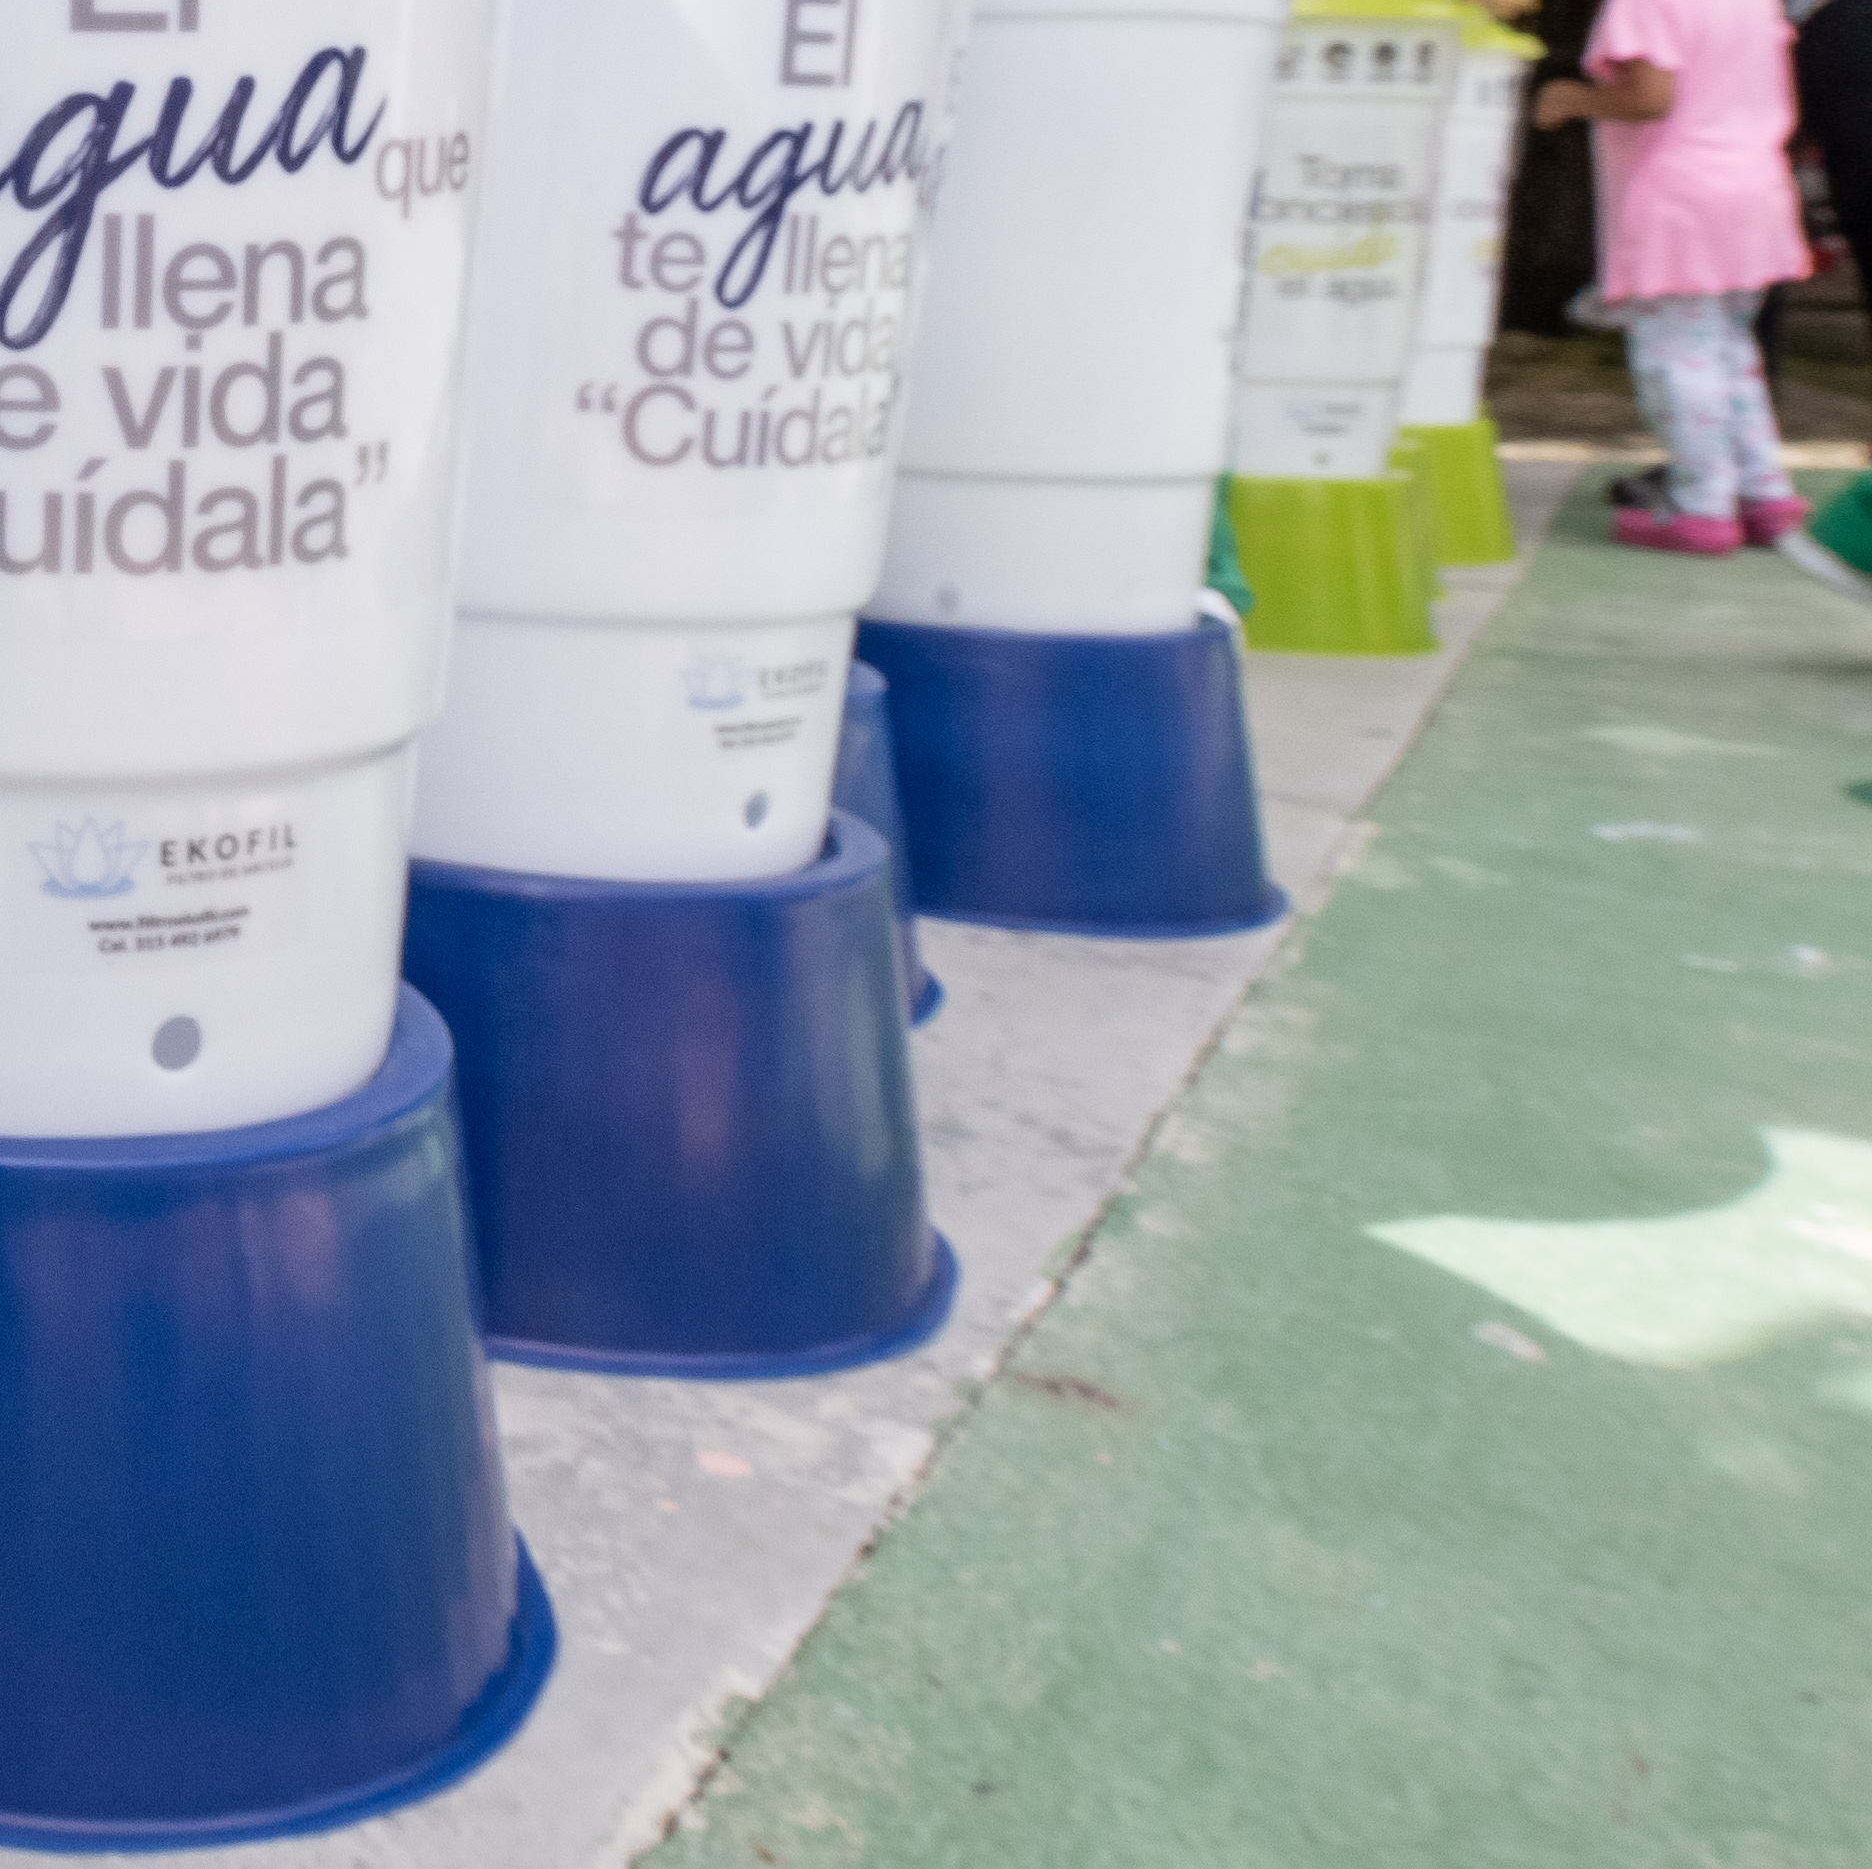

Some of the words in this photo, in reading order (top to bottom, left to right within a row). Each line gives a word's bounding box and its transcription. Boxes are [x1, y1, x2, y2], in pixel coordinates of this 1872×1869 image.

[374, 128, 474, 219] que
[639, 100, 924, 308] agua
[101, 213, 368, 329] llena
[612, 211, 706, 293] te
[636, 298, 754, 380] de
[102, 330, 347, 450] vida
[159, 824, 296, 867] EKOFIL
